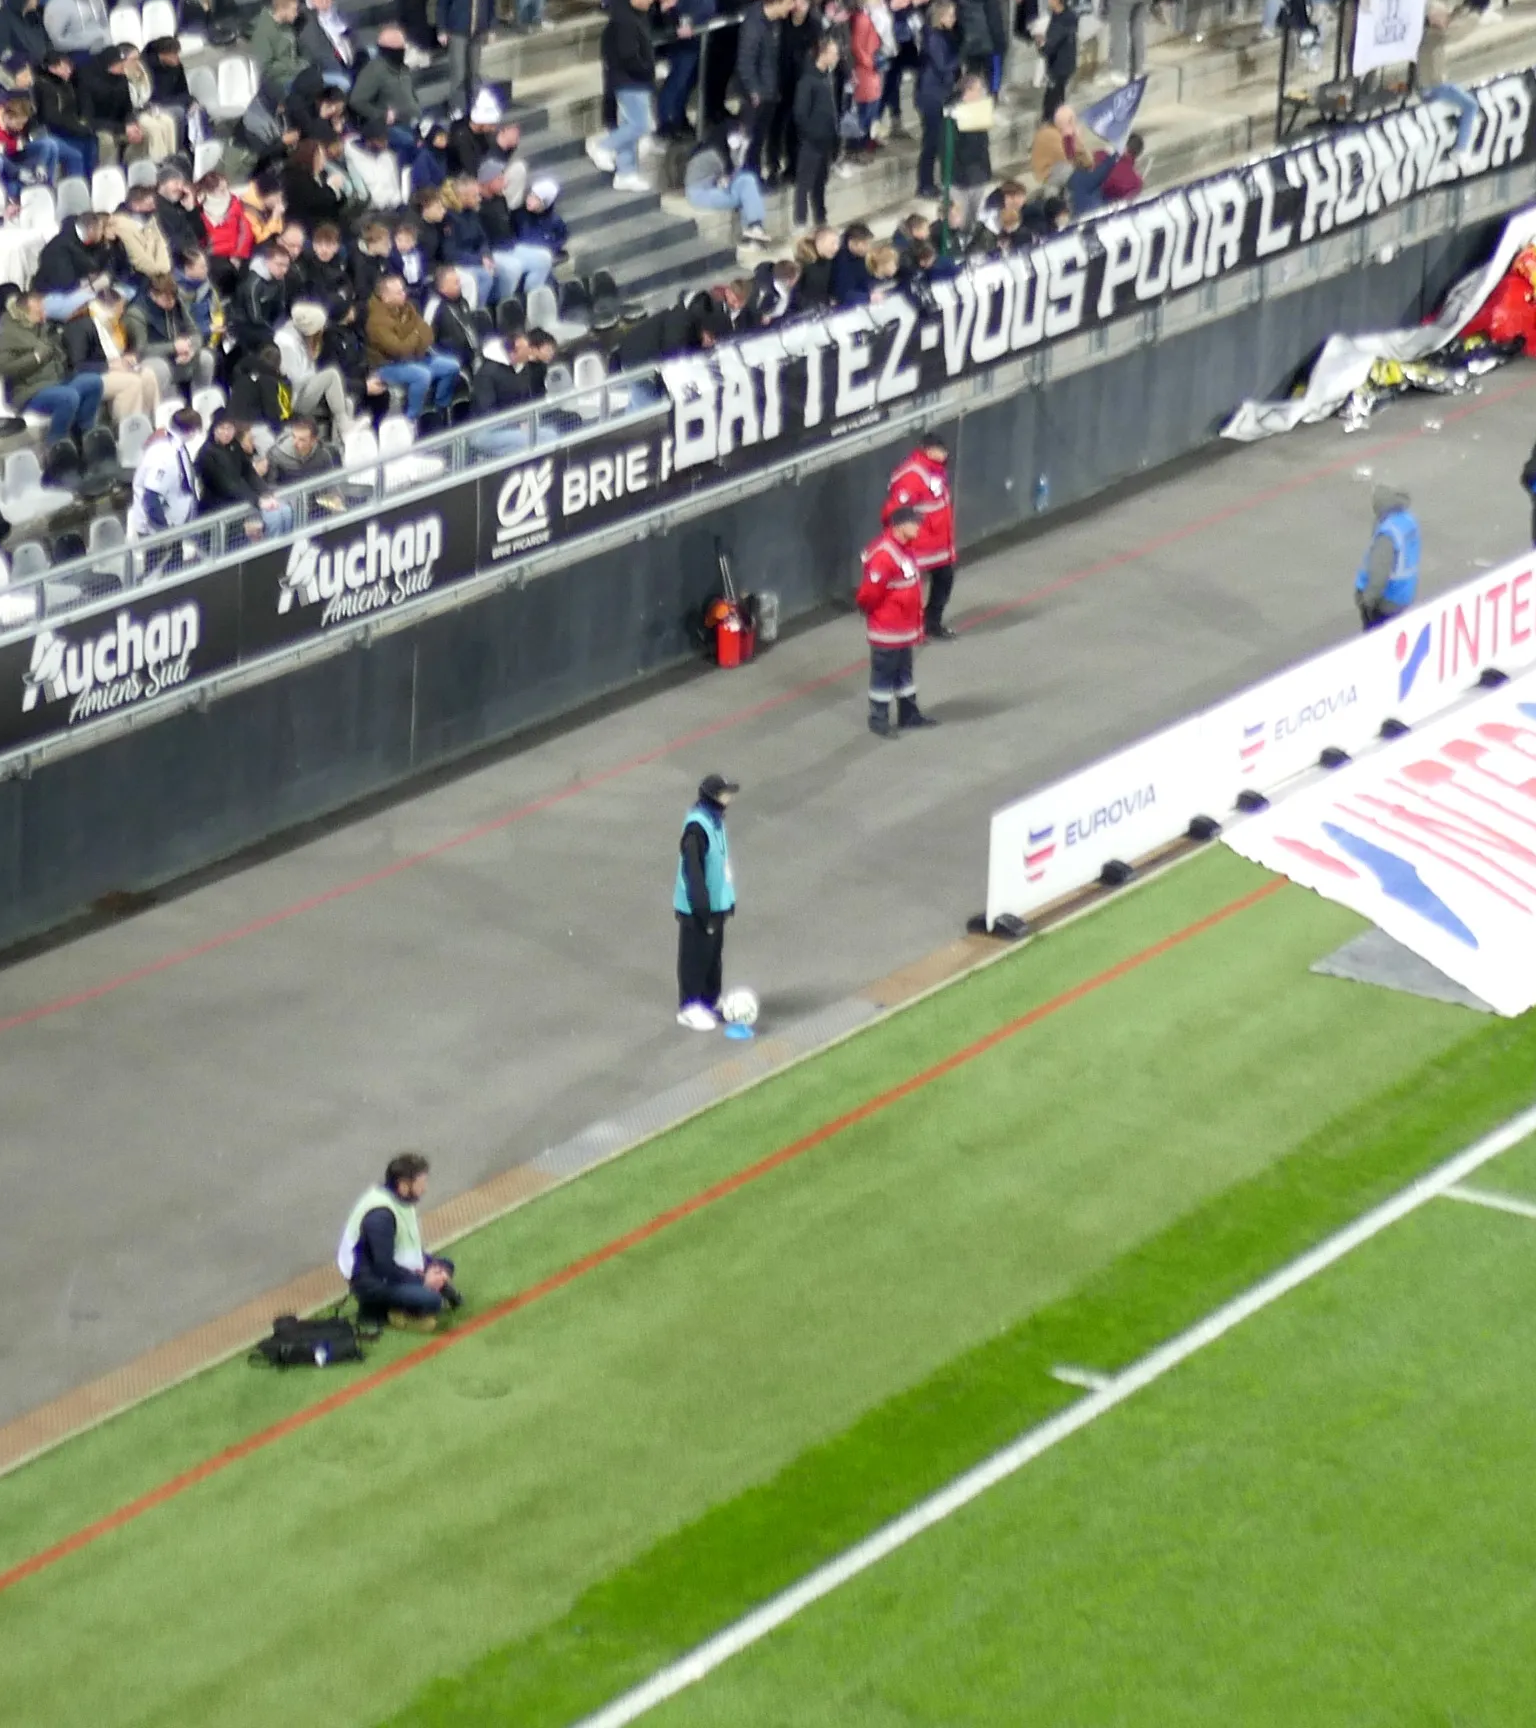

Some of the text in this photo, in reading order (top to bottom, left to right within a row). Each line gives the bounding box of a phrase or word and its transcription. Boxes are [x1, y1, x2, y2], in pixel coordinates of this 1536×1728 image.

[661, 248, 1088, 471] BATTEZ-VOUS
[1096, 175, 1248, 319] POUR
[563, 443, 650, 516] BRIE
[277, 515, 443, 615] Auchan
[321, 557, 435, 628] Amiens Sud
[22, 601, 200, 713] Auchan
[69, 647, 192, 726] Amiens Sud
[1274, 684, 1359, 741] EUROVIA
[1065, 783, 1157, 848] EUROVIA
